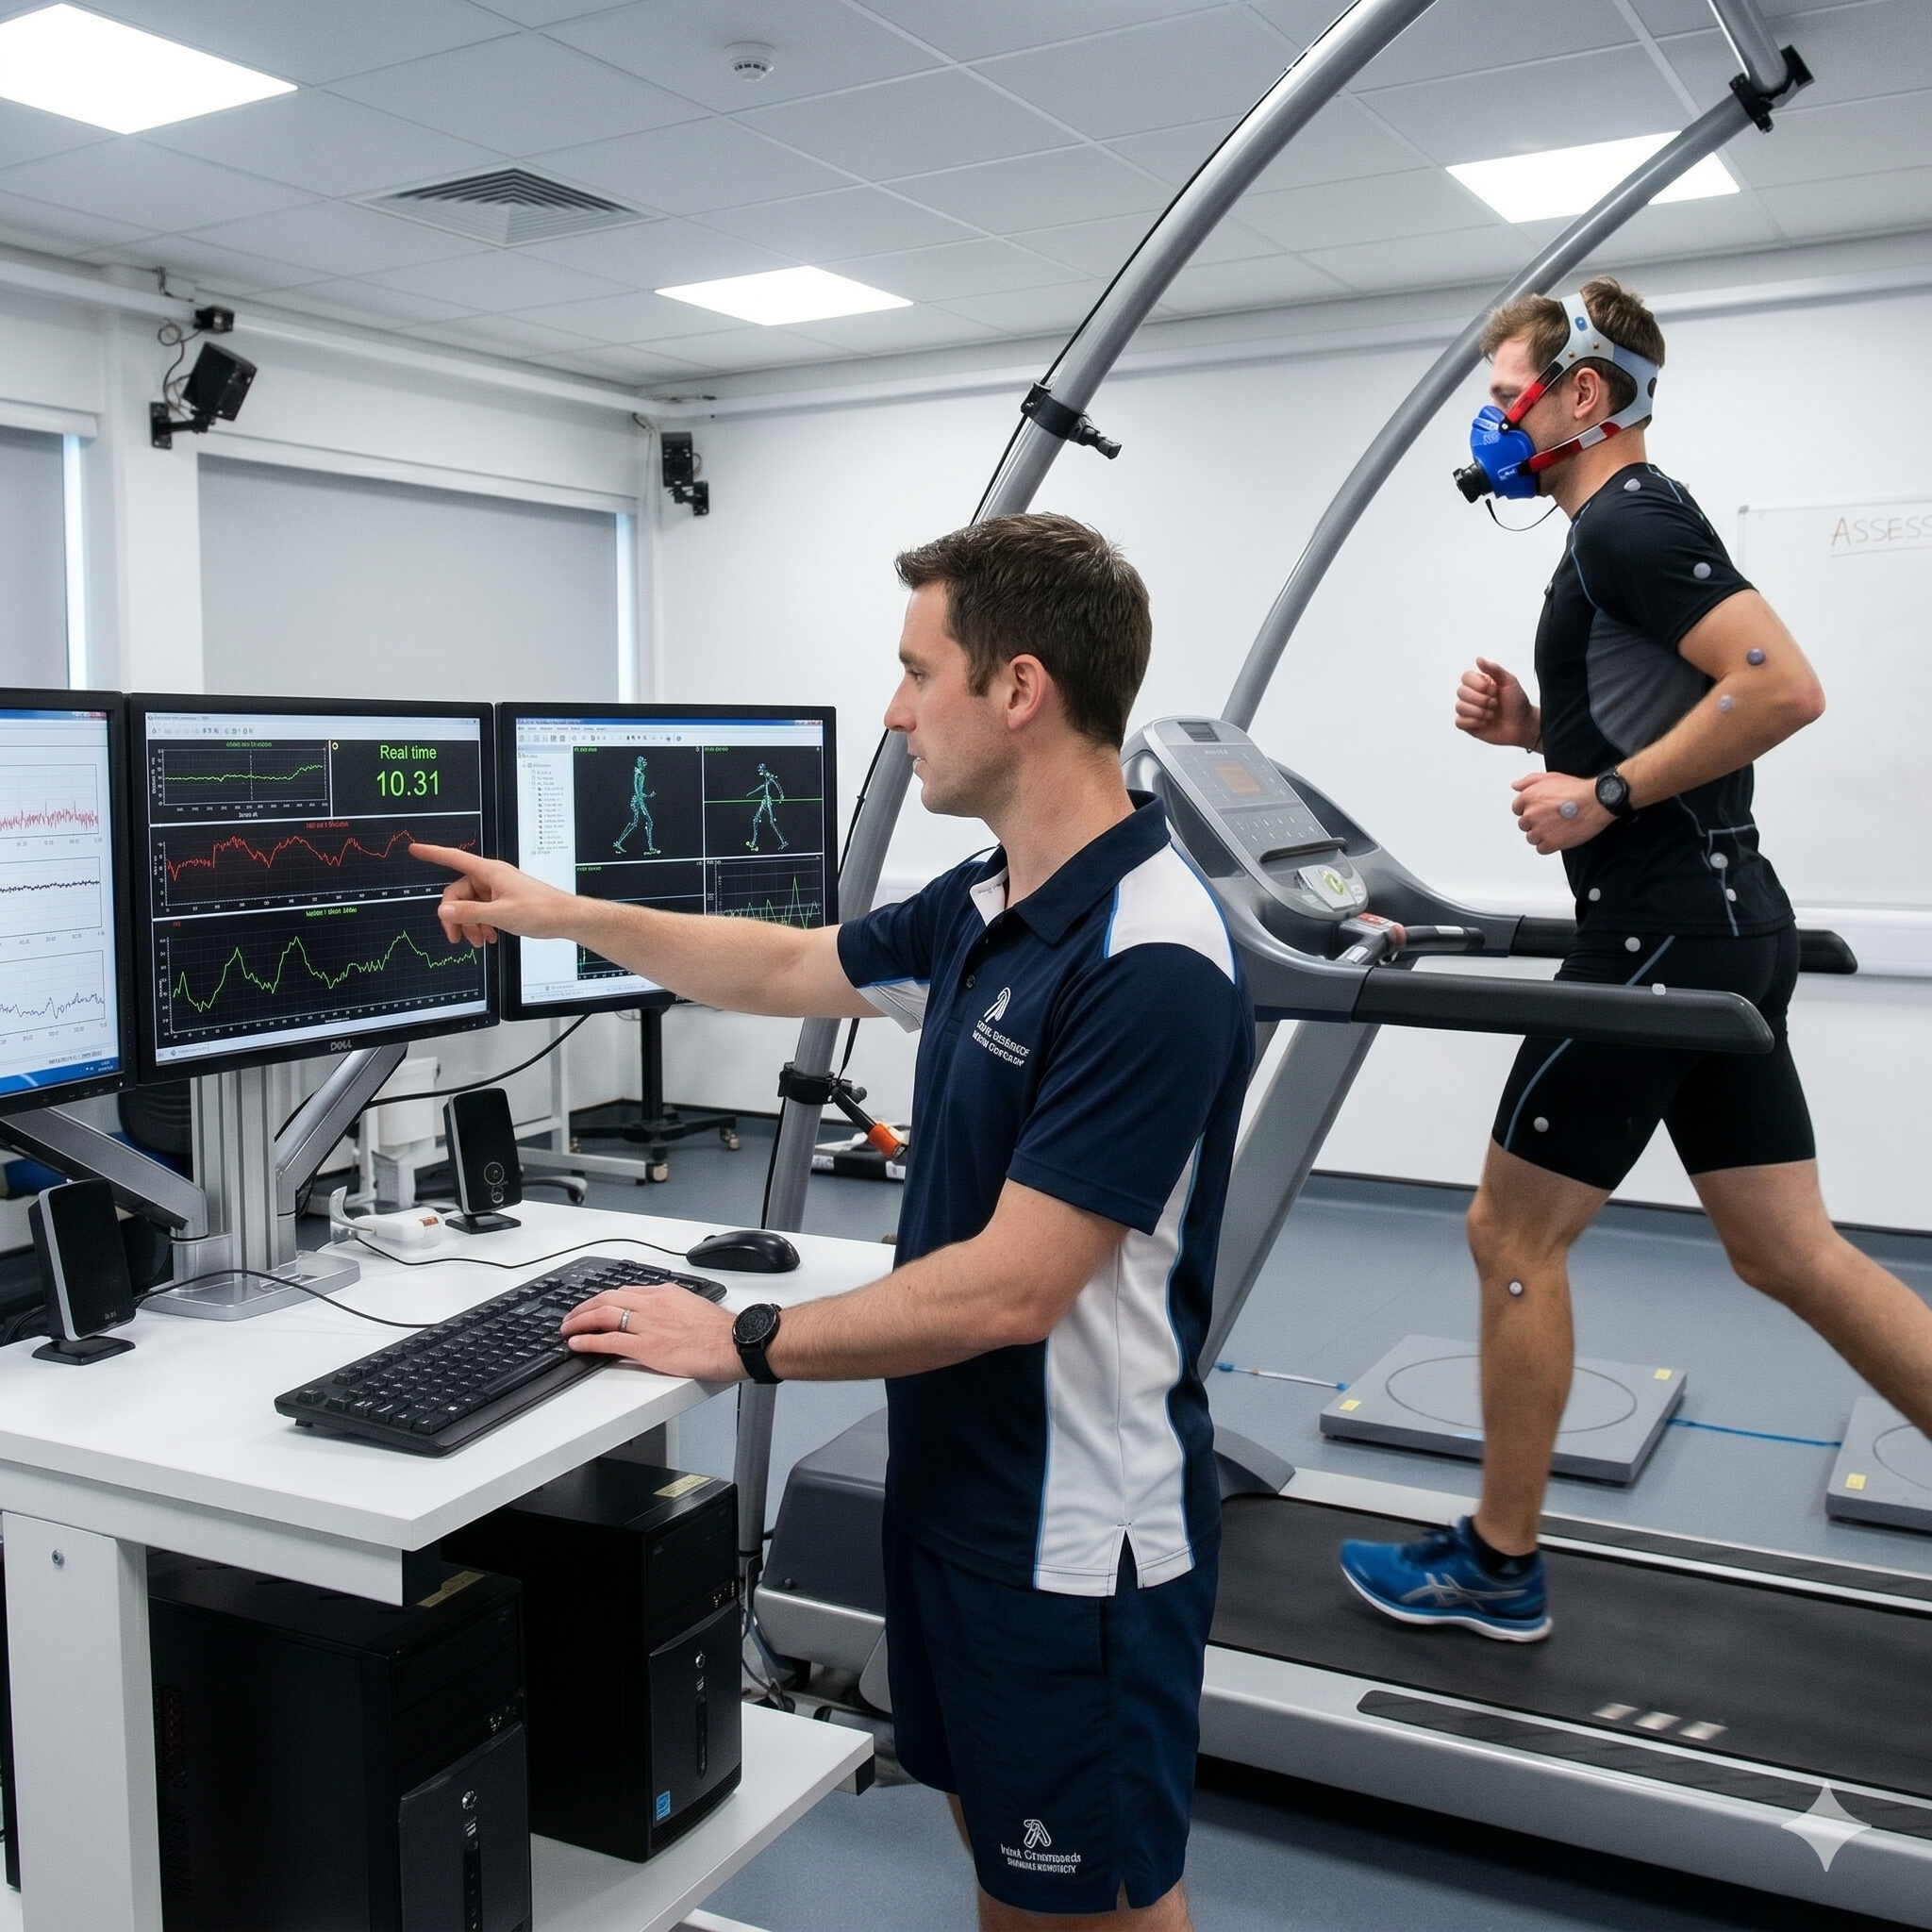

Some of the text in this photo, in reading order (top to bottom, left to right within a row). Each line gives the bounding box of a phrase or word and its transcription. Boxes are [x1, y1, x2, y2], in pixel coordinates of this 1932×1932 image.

[380, 744, 437, 759] Real time
[376, 770, 439, 796] 10.31
